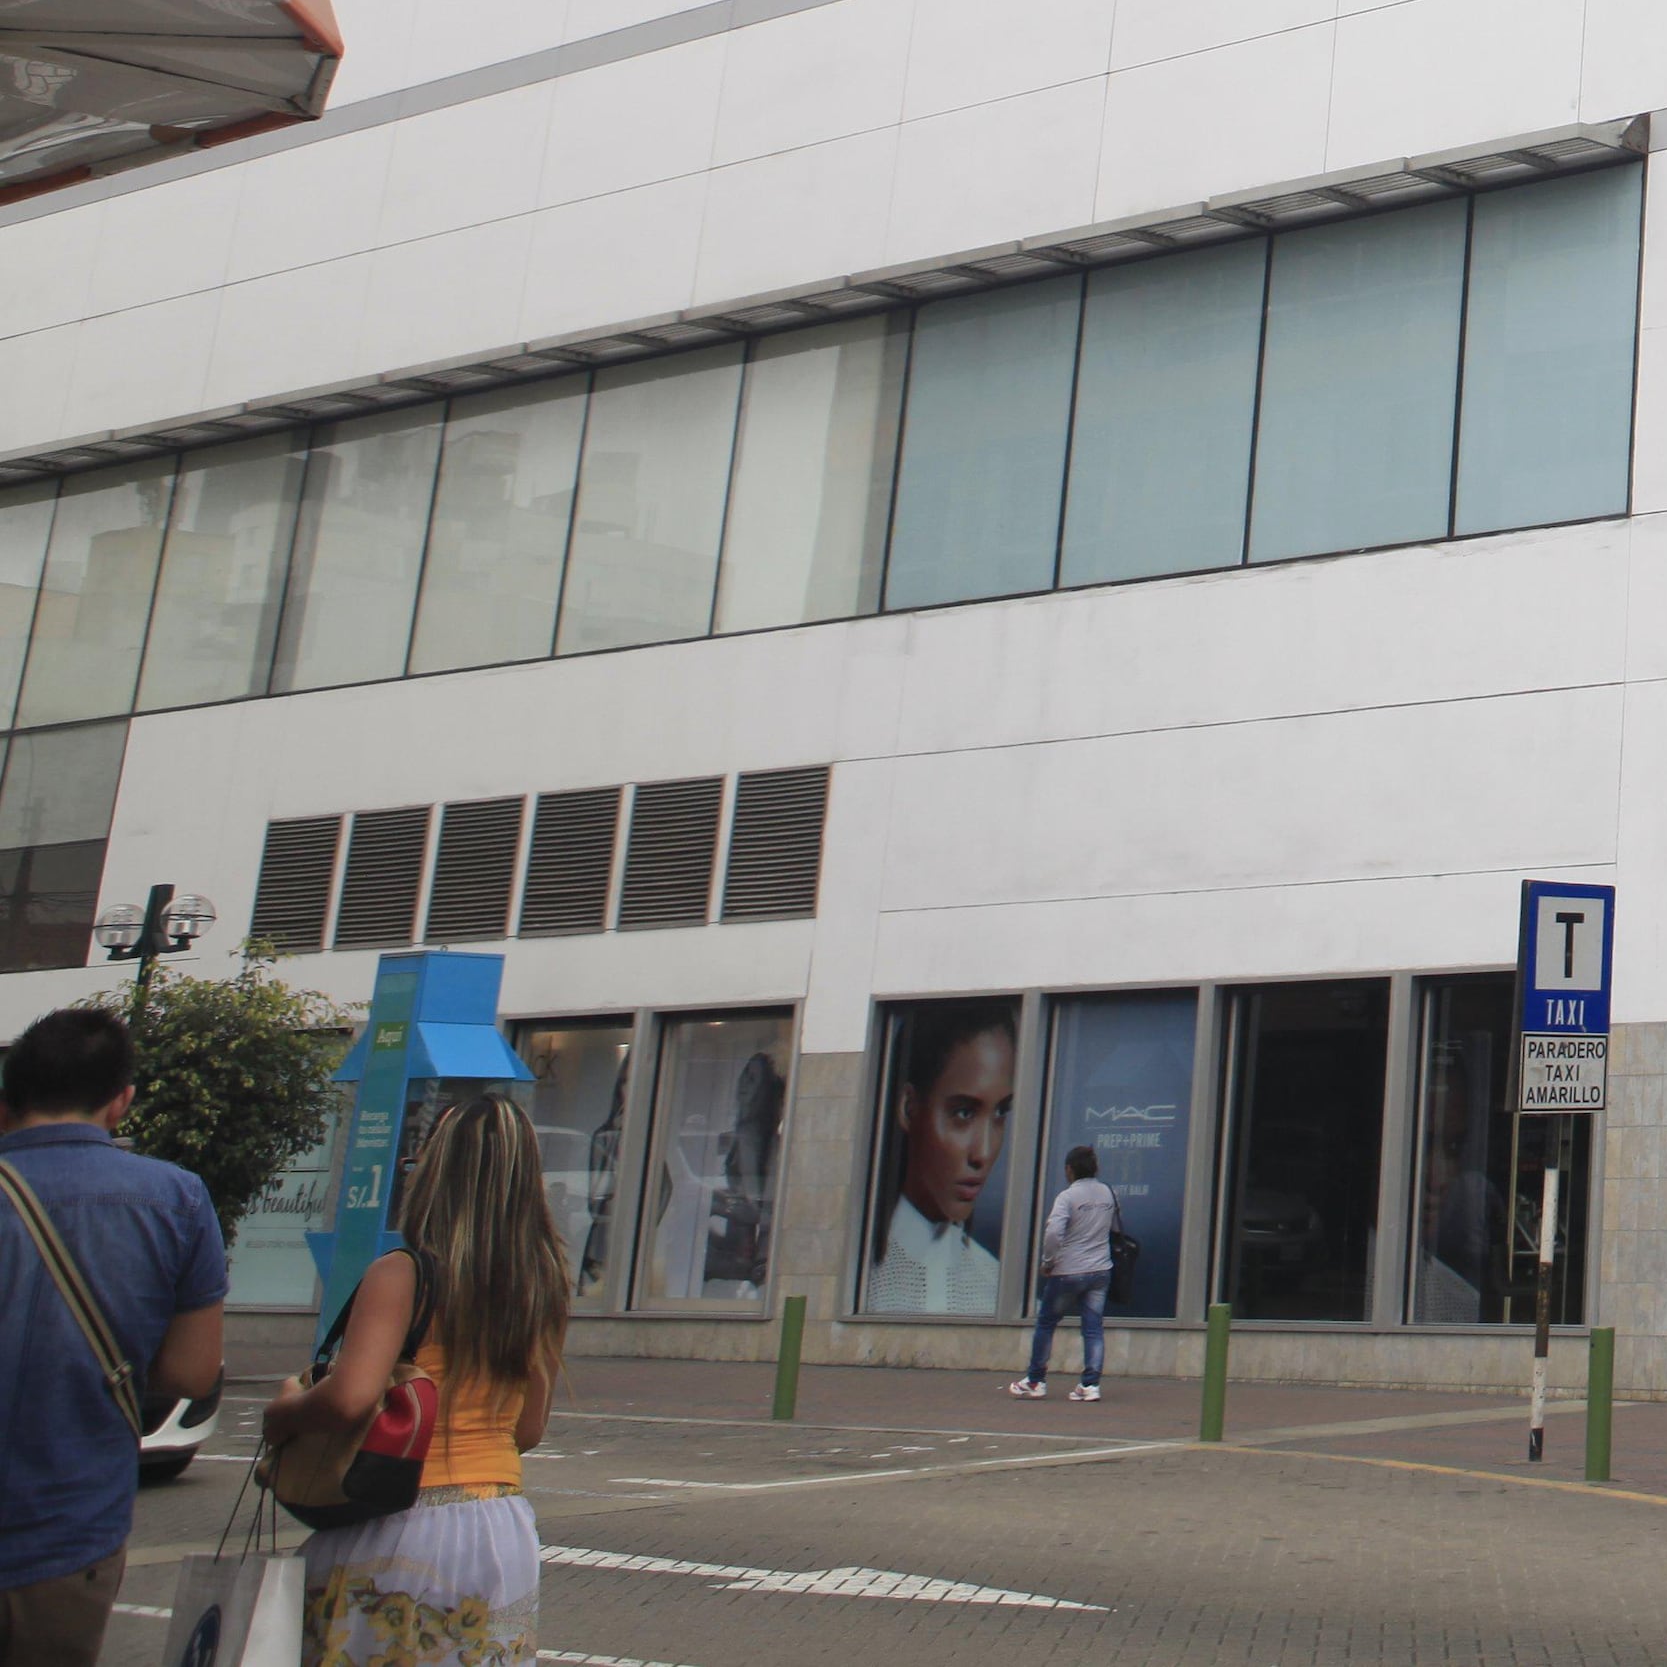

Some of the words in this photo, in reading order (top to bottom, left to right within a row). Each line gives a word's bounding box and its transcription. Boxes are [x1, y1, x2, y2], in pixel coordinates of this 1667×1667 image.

[1555, 912, 1585, 979] T
[1546, 998, 1585, 1026] TAXI
[1527, 1040, 1606, 1060] PARADERO
[1545, 1064, 1581, 1083] TAXI
[1525, 1086, 1601, 1105] AMARILLO
